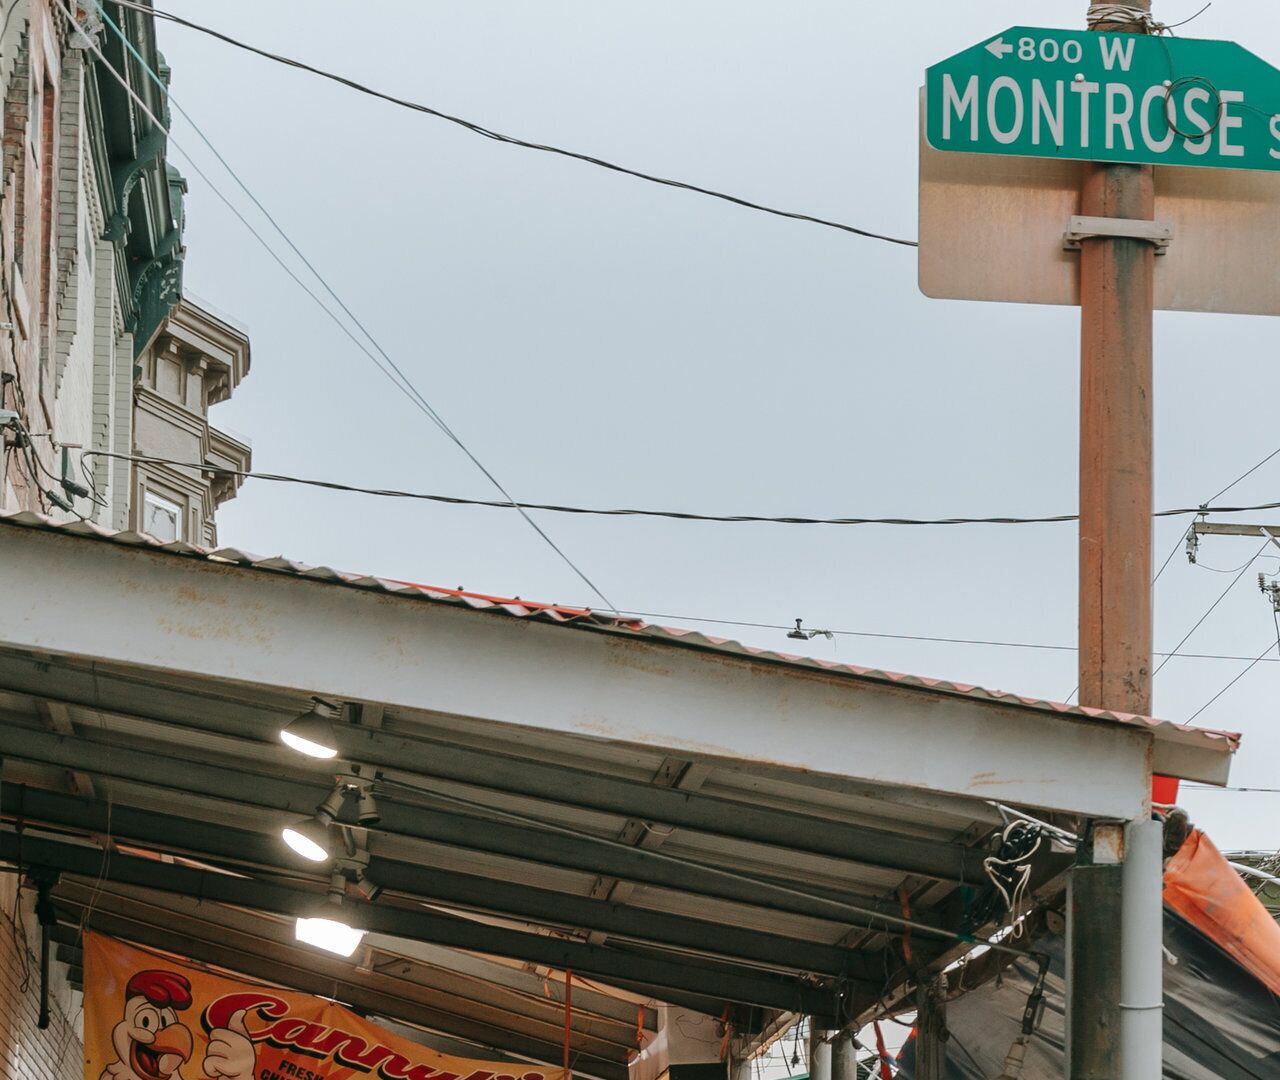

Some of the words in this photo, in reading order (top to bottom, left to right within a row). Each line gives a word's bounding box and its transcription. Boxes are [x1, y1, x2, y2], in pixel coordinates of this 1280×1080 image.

[1017, 37, 1083, 63] 800
[1099, 37, 1136, 71] W
[942, 73, 1245, 157] MONTROSE
